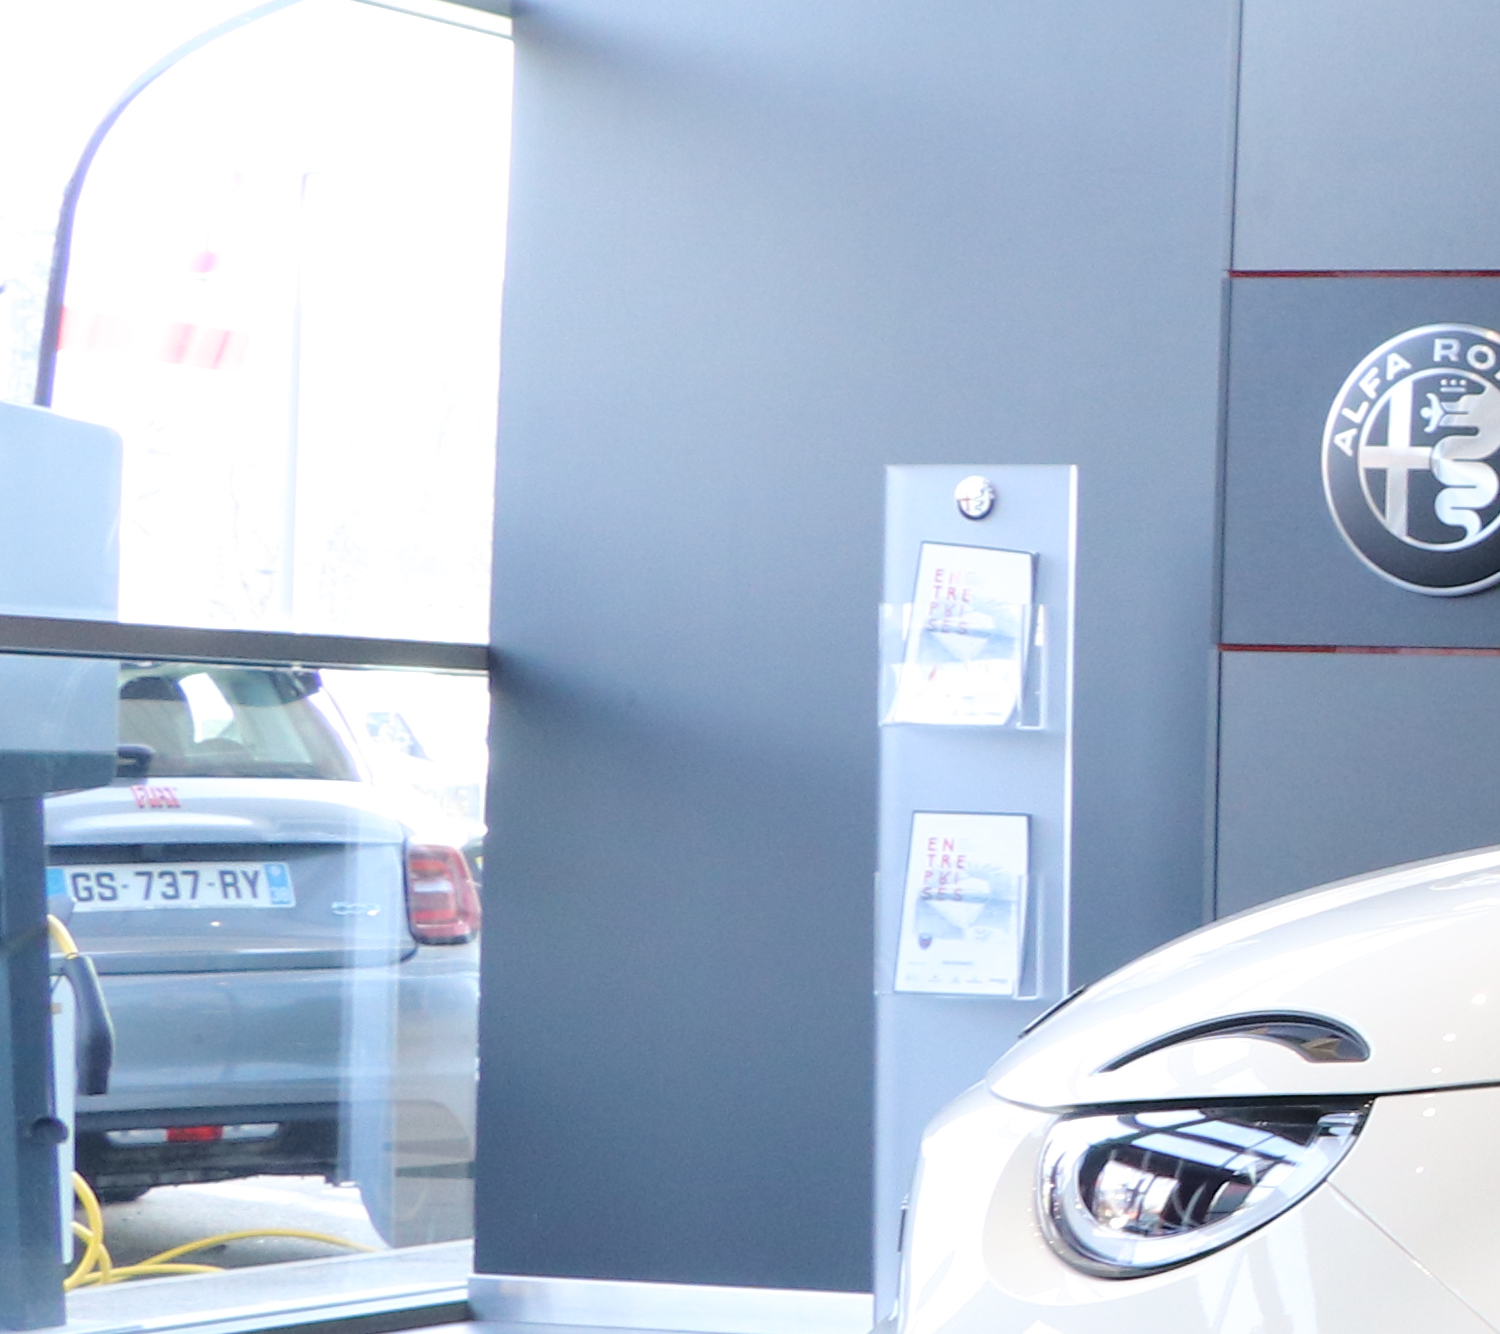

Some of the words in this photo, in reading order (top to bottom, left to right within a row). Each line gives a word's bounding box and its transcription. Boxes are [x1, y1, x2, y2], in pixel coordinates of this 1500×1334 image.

[1333, 352, 1412, 457] ALFA
[933, 585, 972, 603] TRE
[926, 837, 955, 852] EN
[926, 853, 967, 869] TRE
[70, 869, 262, 902] GS-737-RY
[921, 886, 963, 902] SES
